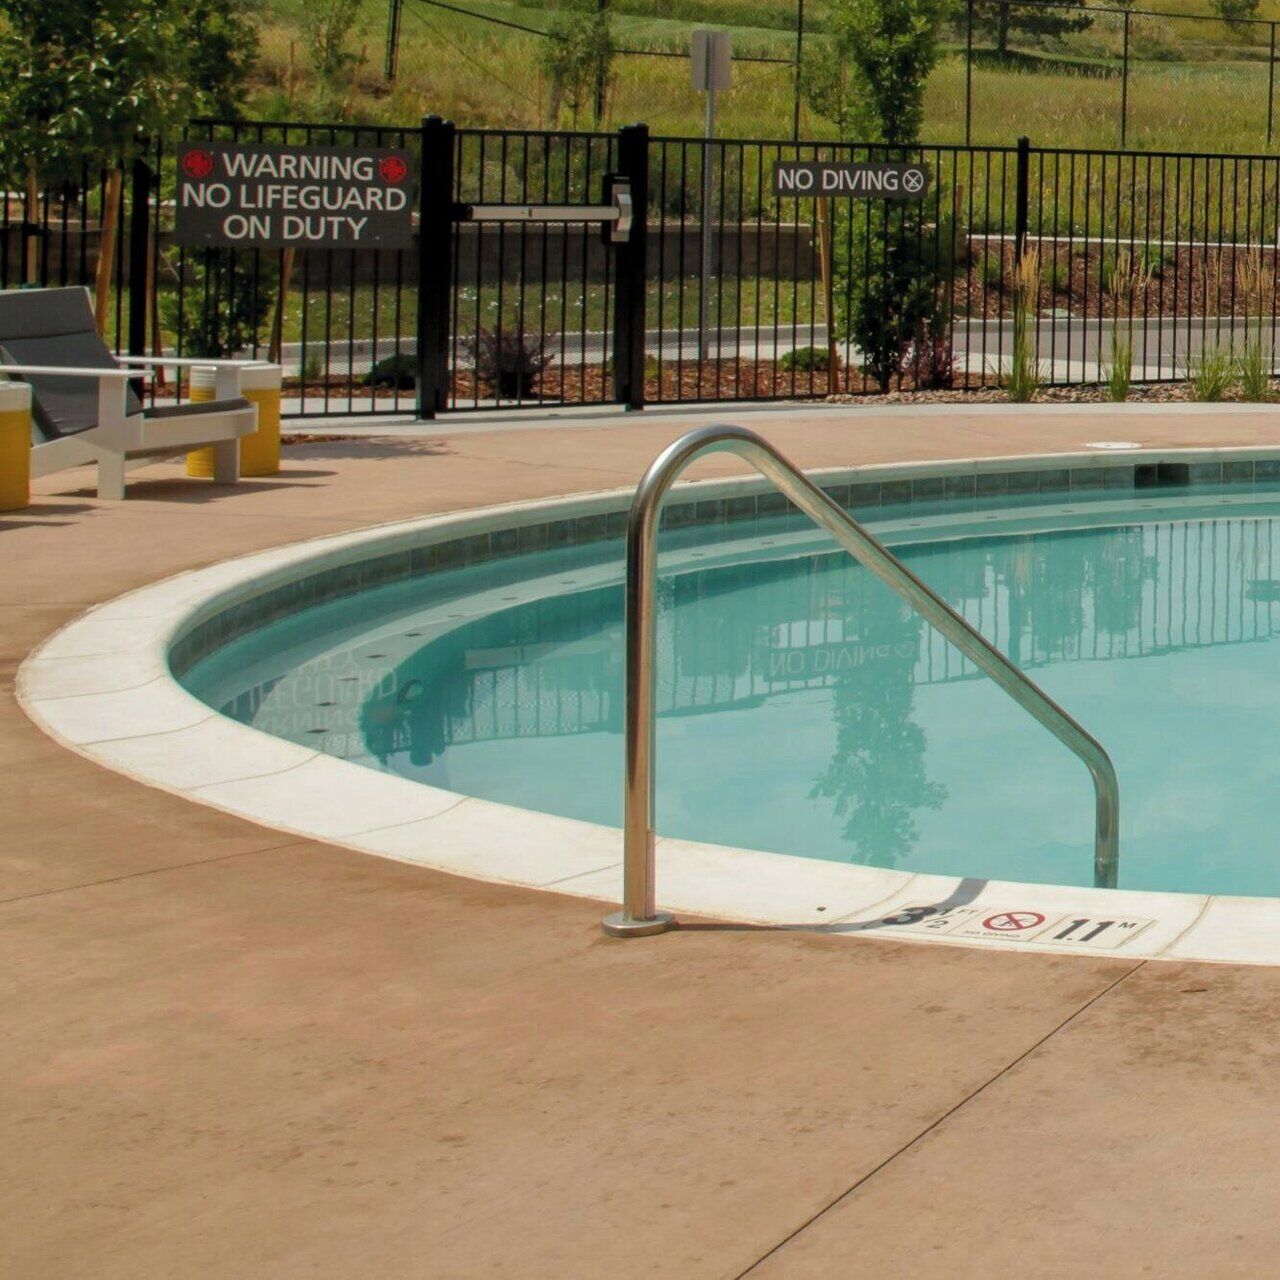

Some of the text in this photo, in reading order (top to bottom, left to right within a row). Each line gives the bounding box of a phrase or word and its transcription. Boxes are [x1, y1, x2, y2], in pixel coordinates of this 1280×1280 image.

[223, 153, 374, 181] WARNING
[778, 169, 899, 191] NO DIVING
[182, 183, 407, 211] NO LIFEGUARD
[223, 214, 368, 240] ON DUTY
[883, 907, 938, 925] 3
